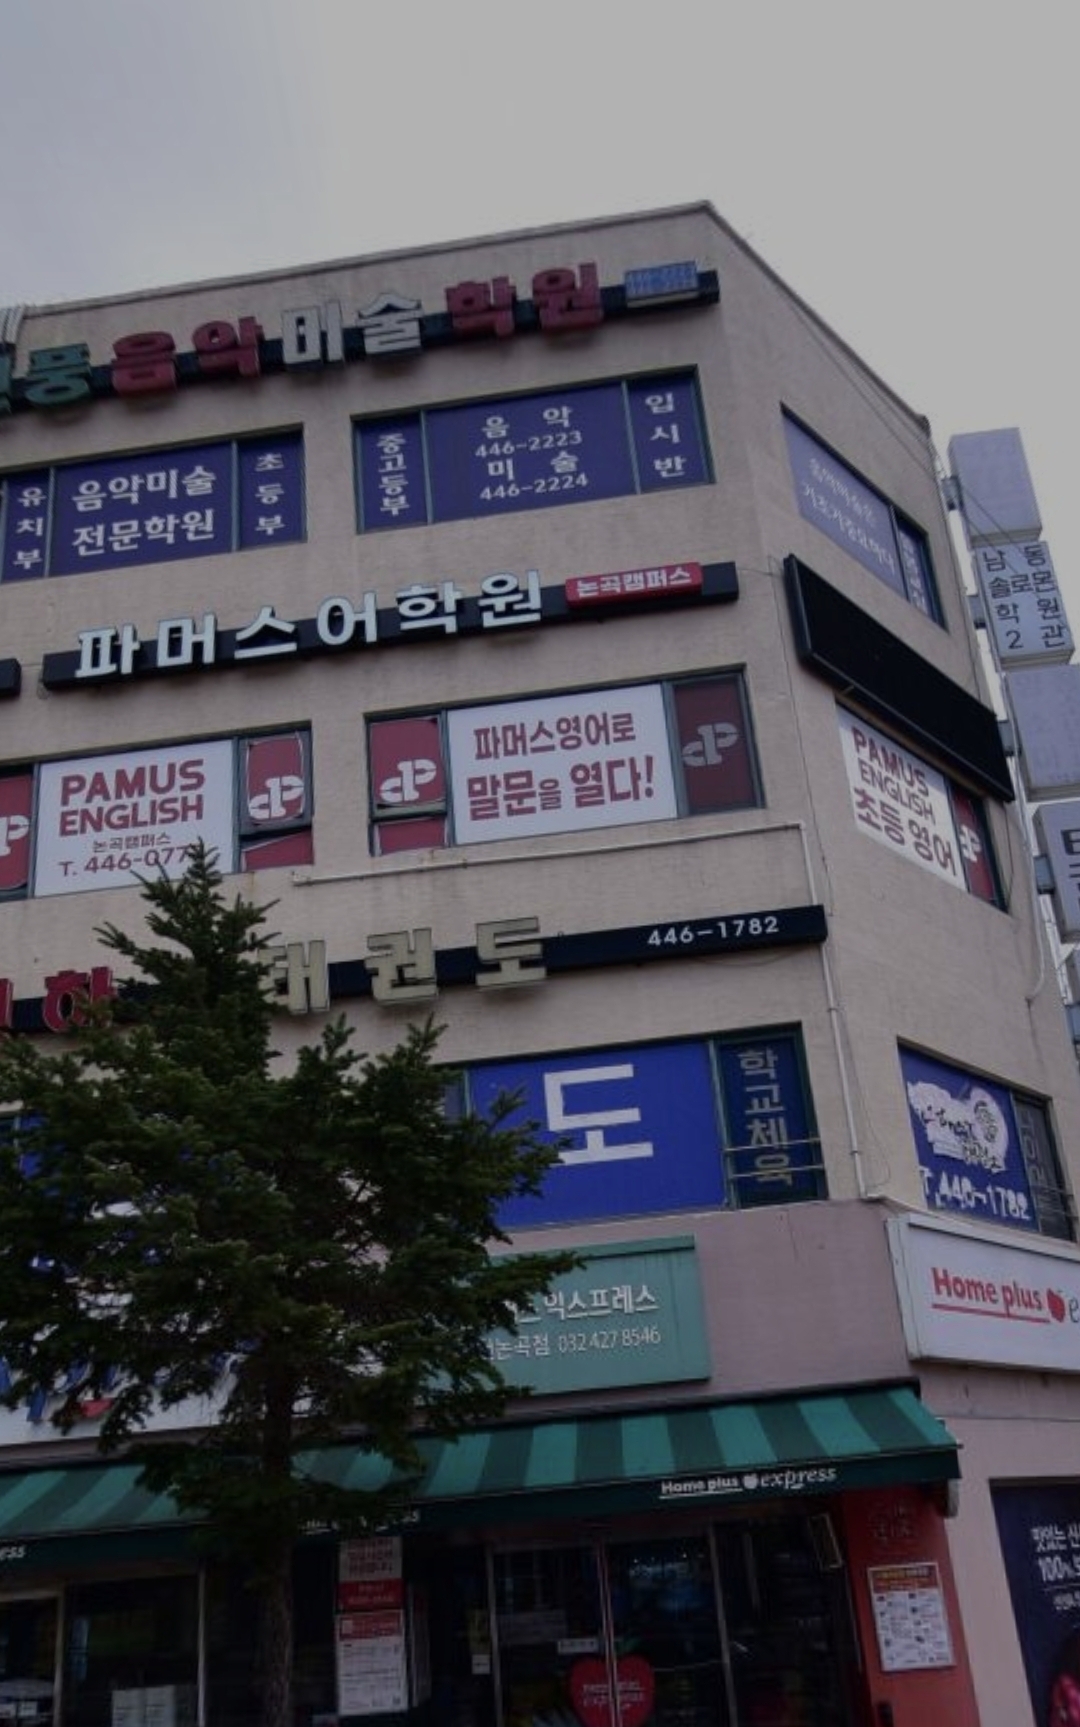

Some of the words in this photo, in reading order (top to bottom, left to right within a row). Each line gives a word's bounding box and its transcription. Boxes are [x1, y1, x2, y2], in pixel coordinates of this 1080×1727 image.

[475, 430, 583, 459] 446-2223
[72, 464, 217, 513] 음악미술
[376, 432, 410, 516] 중고등부
[480, 473, 589, 501] 446-2224
[72, 508, 216, 557] 전문학원
[576, 566, 693, 598] 논곡캠퍼스
[474, 713, 636, 760] 파머스영어로
[60, 759, 206, 806] PAMUS
[570, 756, 655, 808] 열다!
[852, 727, 929, 797] PAMUS
[59, 794, 204, 837] ENGLISH
[860, 761, 937, 825] ENGLISH
[93, 832, 171, 853] 논곡캠퍼스
[648, 917, 780, 947] 446-1782
[932, 1267, 998, 1304] Home
[1002, 1282, 1043, 1318] plus
